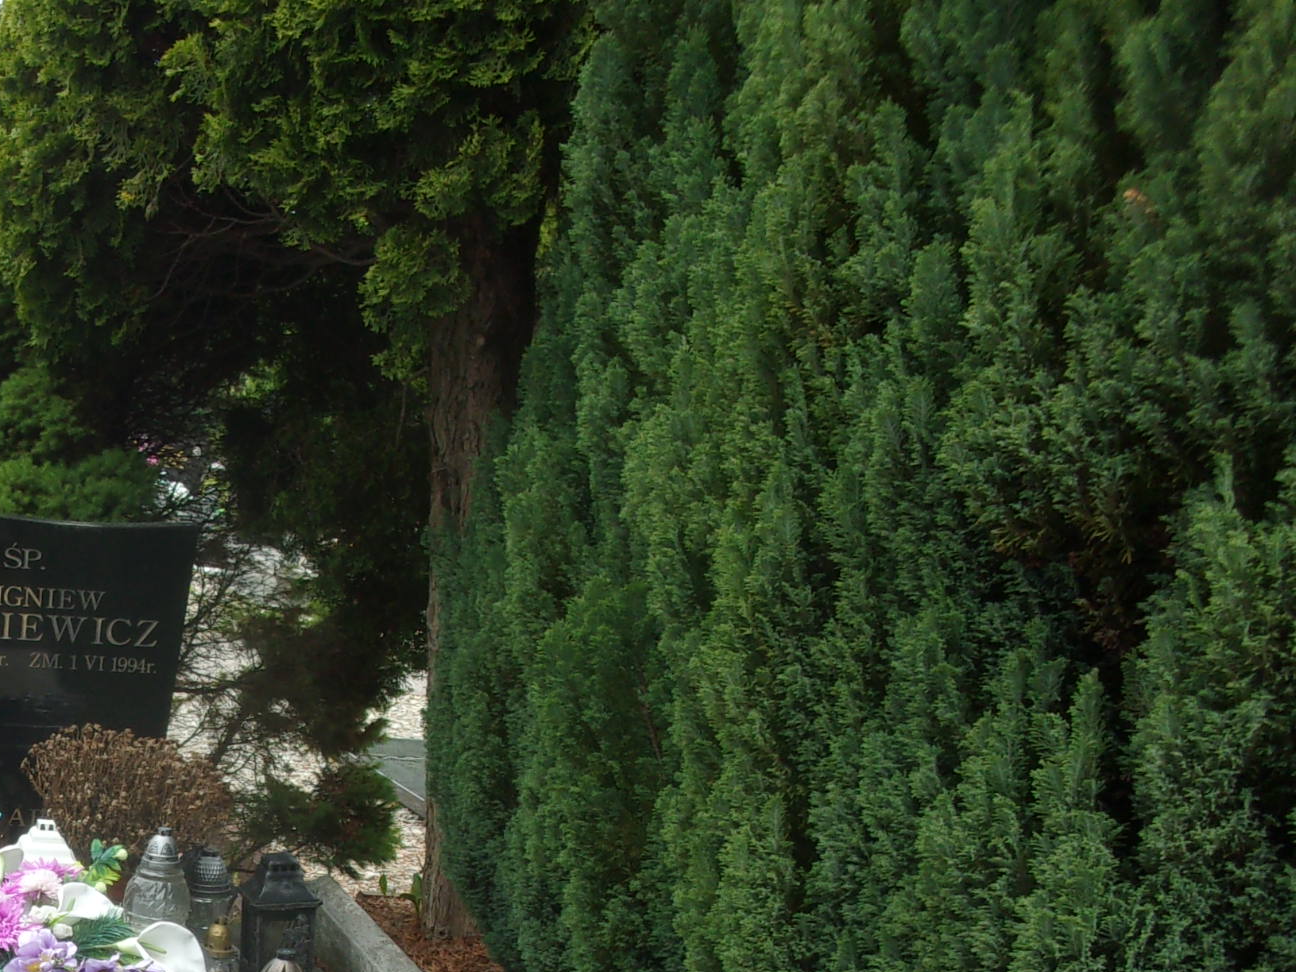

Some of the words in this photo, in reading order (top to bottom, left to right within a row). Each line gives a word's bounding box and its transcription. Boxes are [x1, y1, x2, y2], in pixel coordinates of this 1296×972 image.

[29, 652, 64, 669] ZM.
[84, 654, 105, 672] VI
[111, 656, 157, 674] 1994r.
